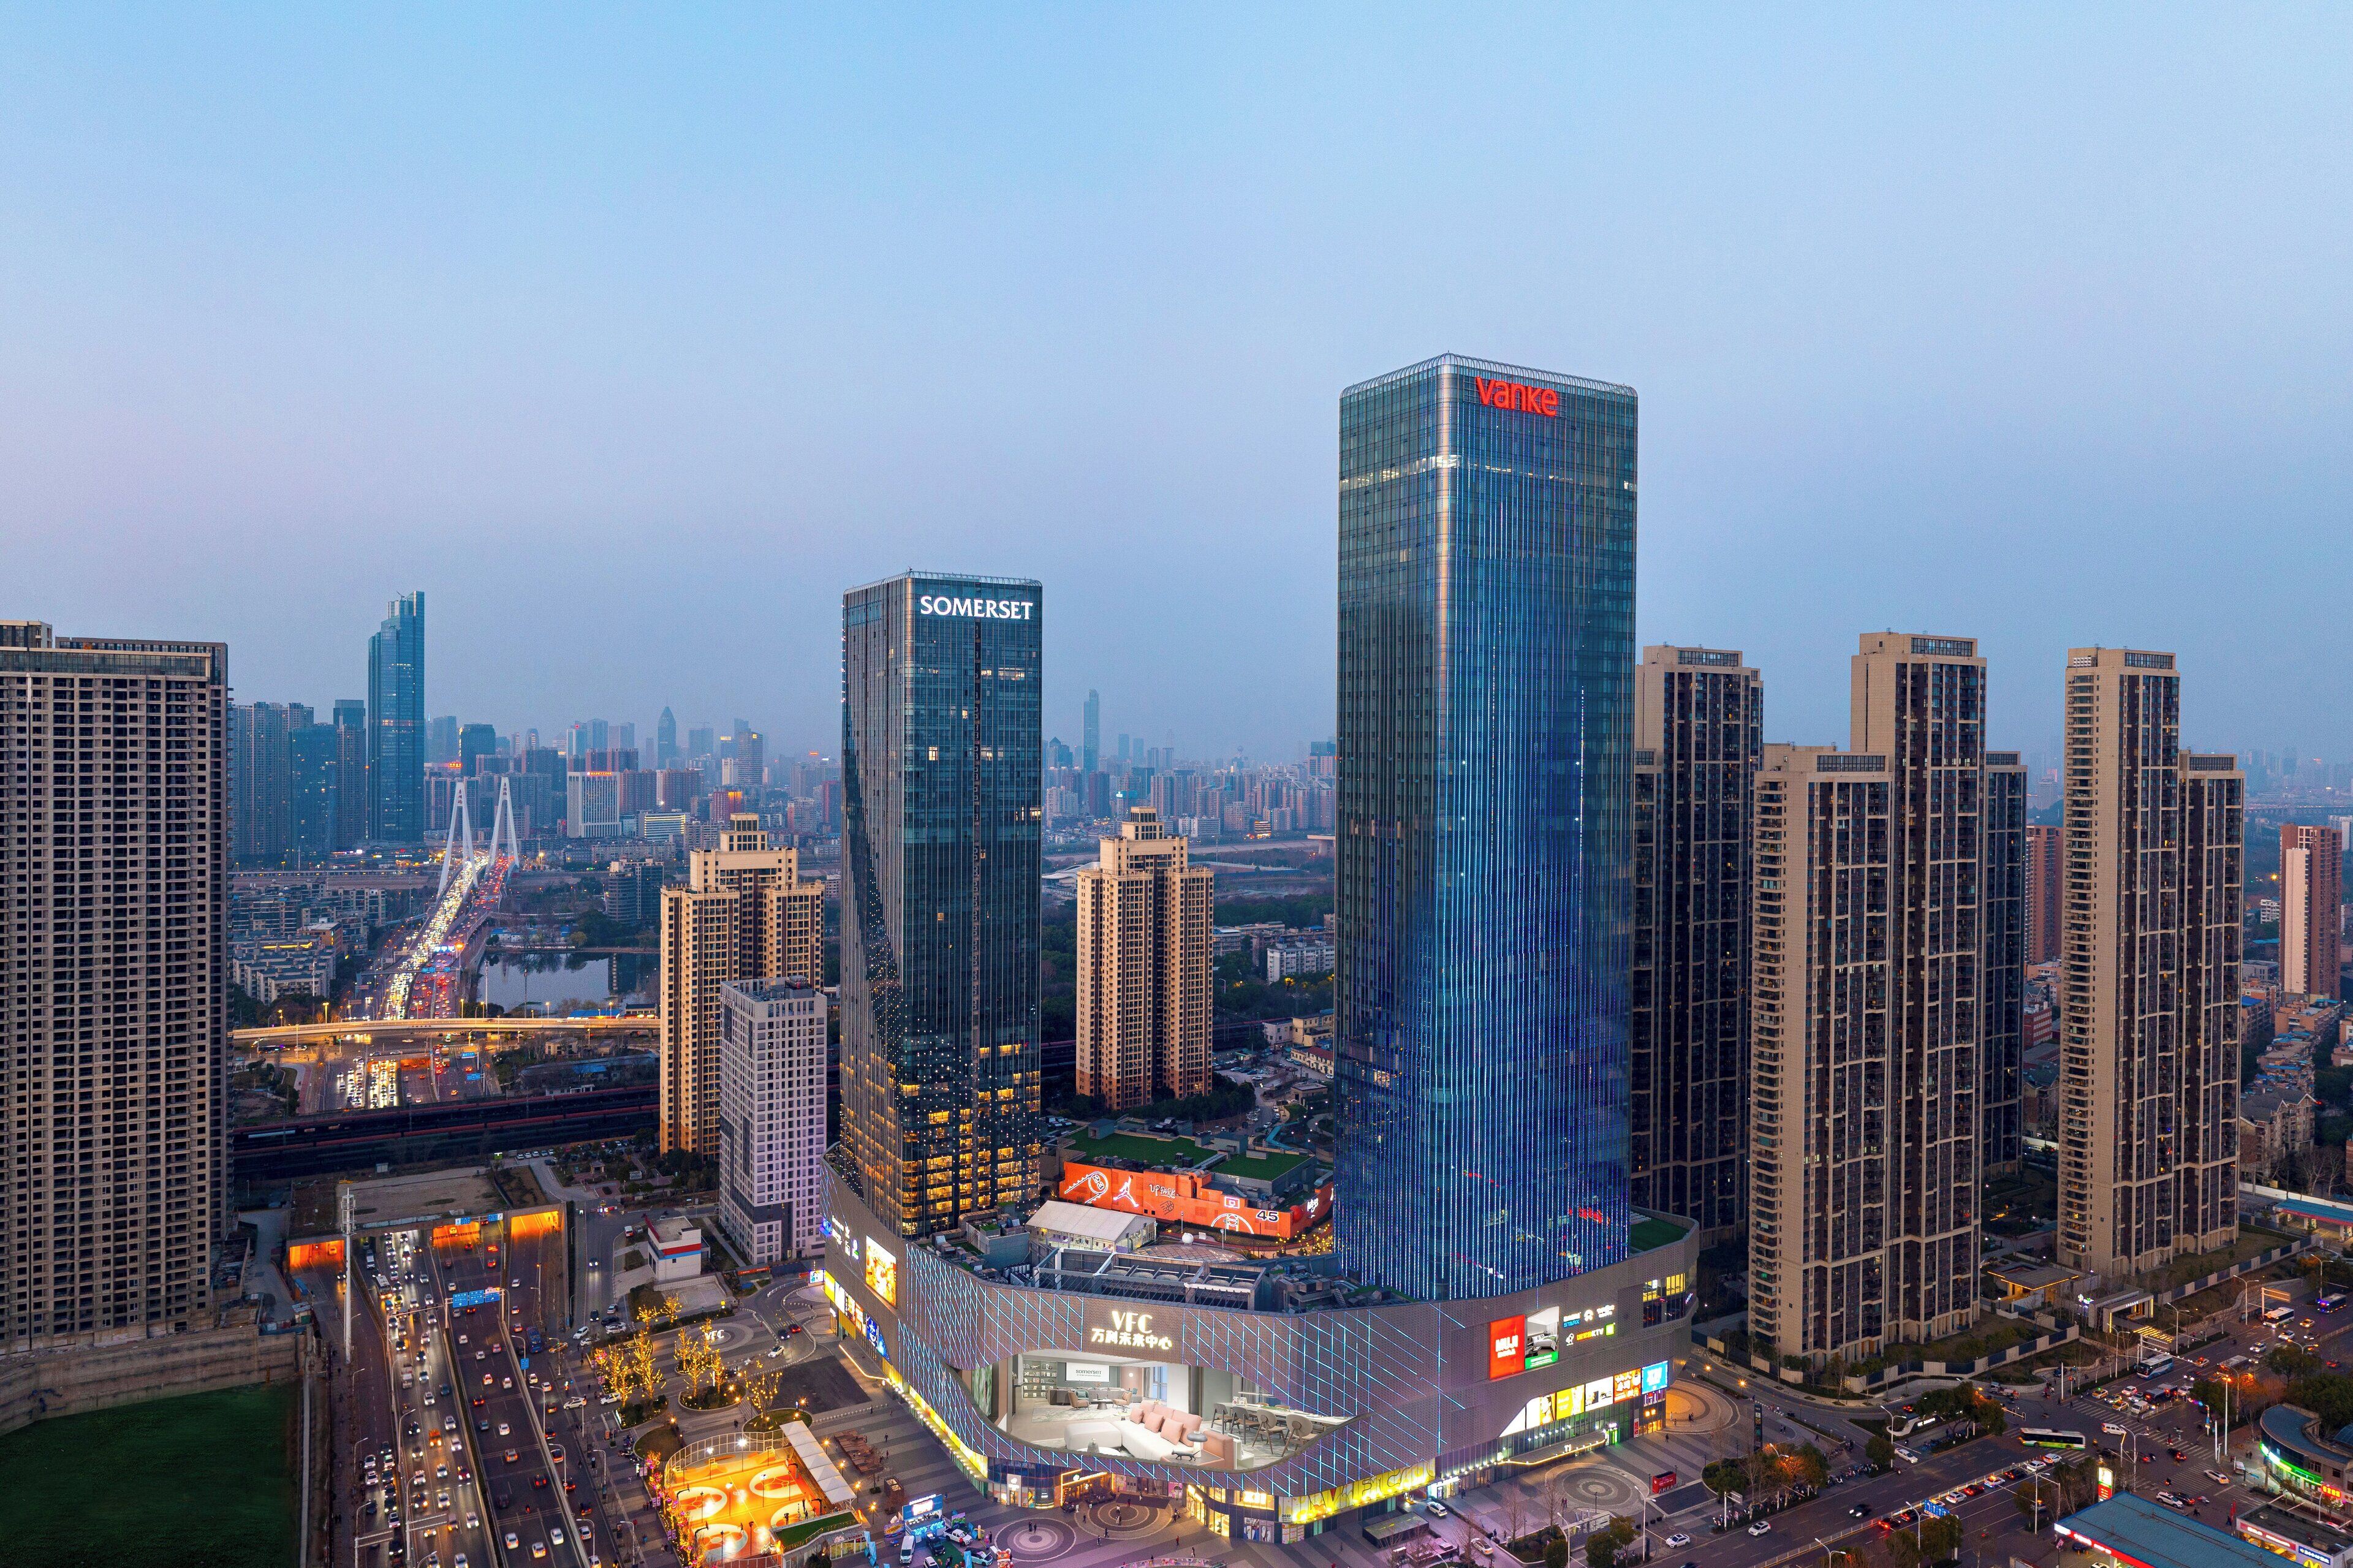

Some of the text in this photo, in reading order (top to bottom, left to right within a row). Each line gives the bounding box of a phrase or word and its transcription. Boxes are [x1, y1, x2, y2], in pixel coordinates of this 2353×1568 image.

[1476, 376, 1558, 417] vanke
[920, 596, 1033, 619] SOMERSET
[1256, 1210, 1279, 1222] 45
[1112, 1311, 1153, 1334] VFC
[1091, 1328, 1173, 1350] 万科未来中心
